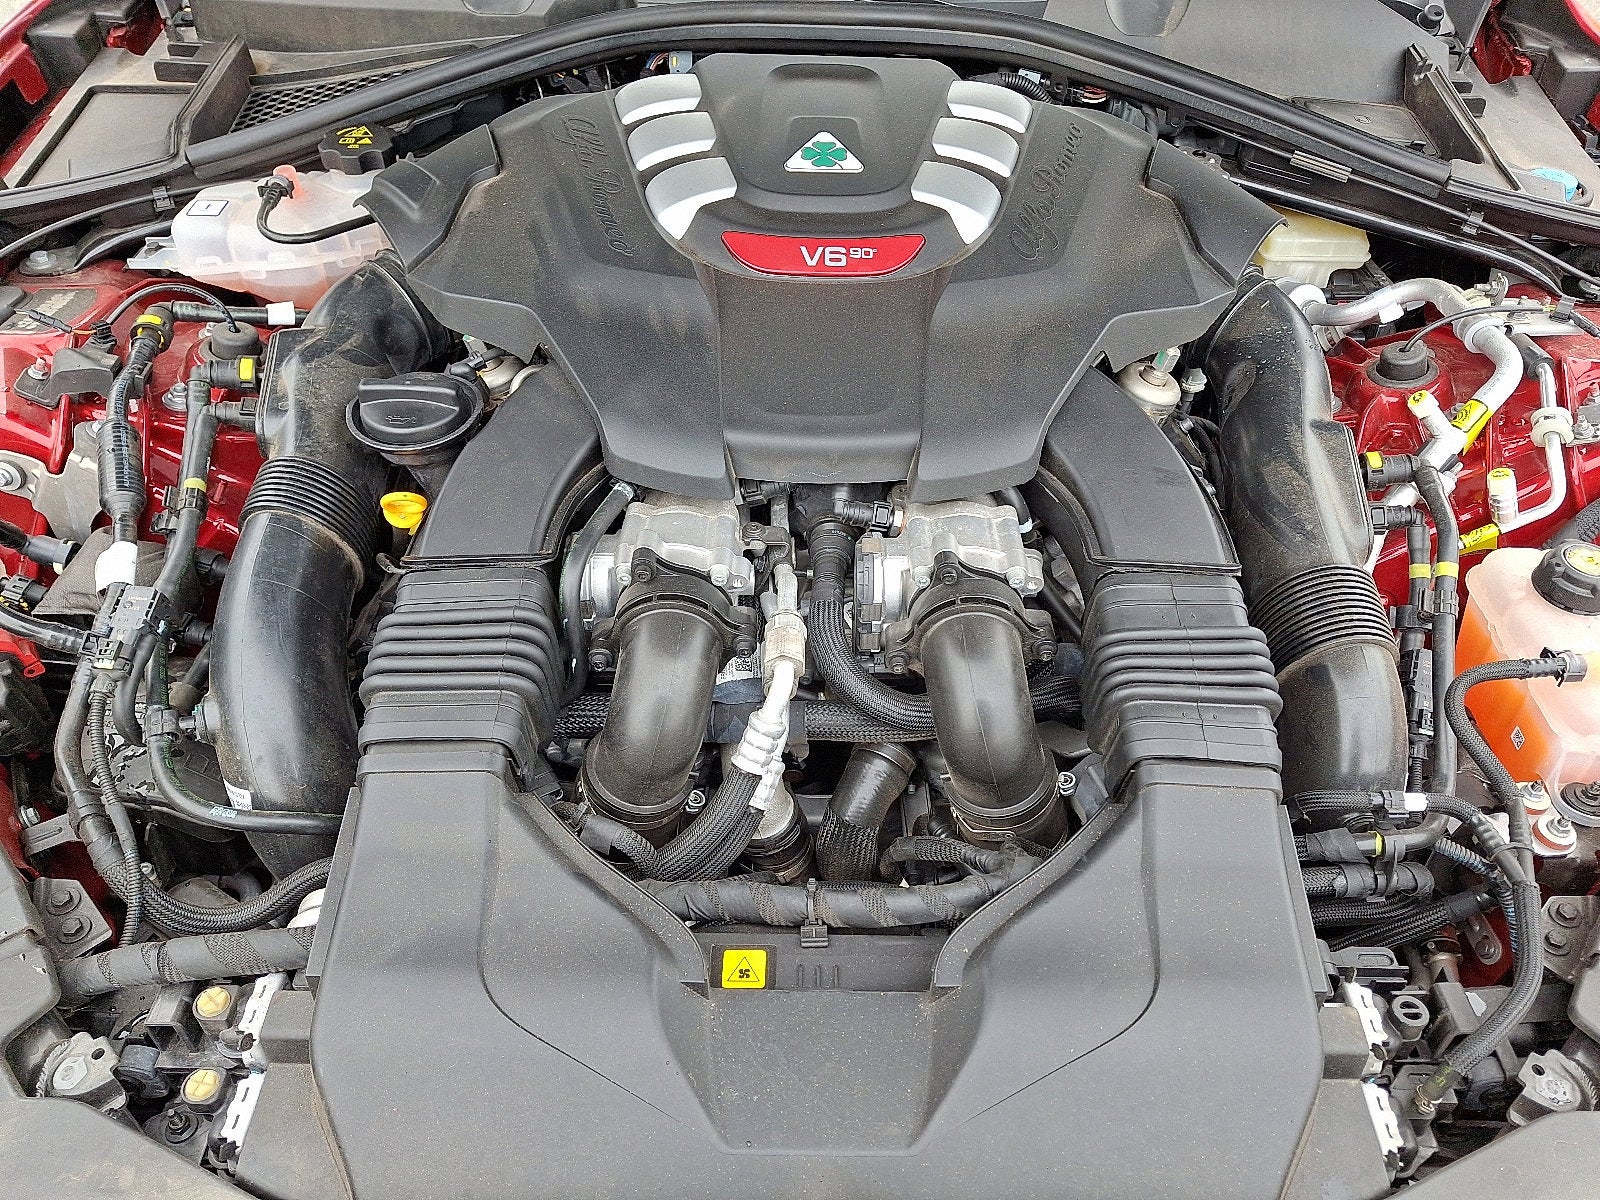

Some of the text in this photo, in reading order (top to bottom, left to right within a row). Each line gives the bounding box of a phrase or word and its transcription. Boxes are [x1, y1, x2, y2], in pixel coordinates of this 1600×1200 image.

[552, 114, 639, 257] Alfa Romeo
[1006, 121, 1084, 260] Alfa Romeo
